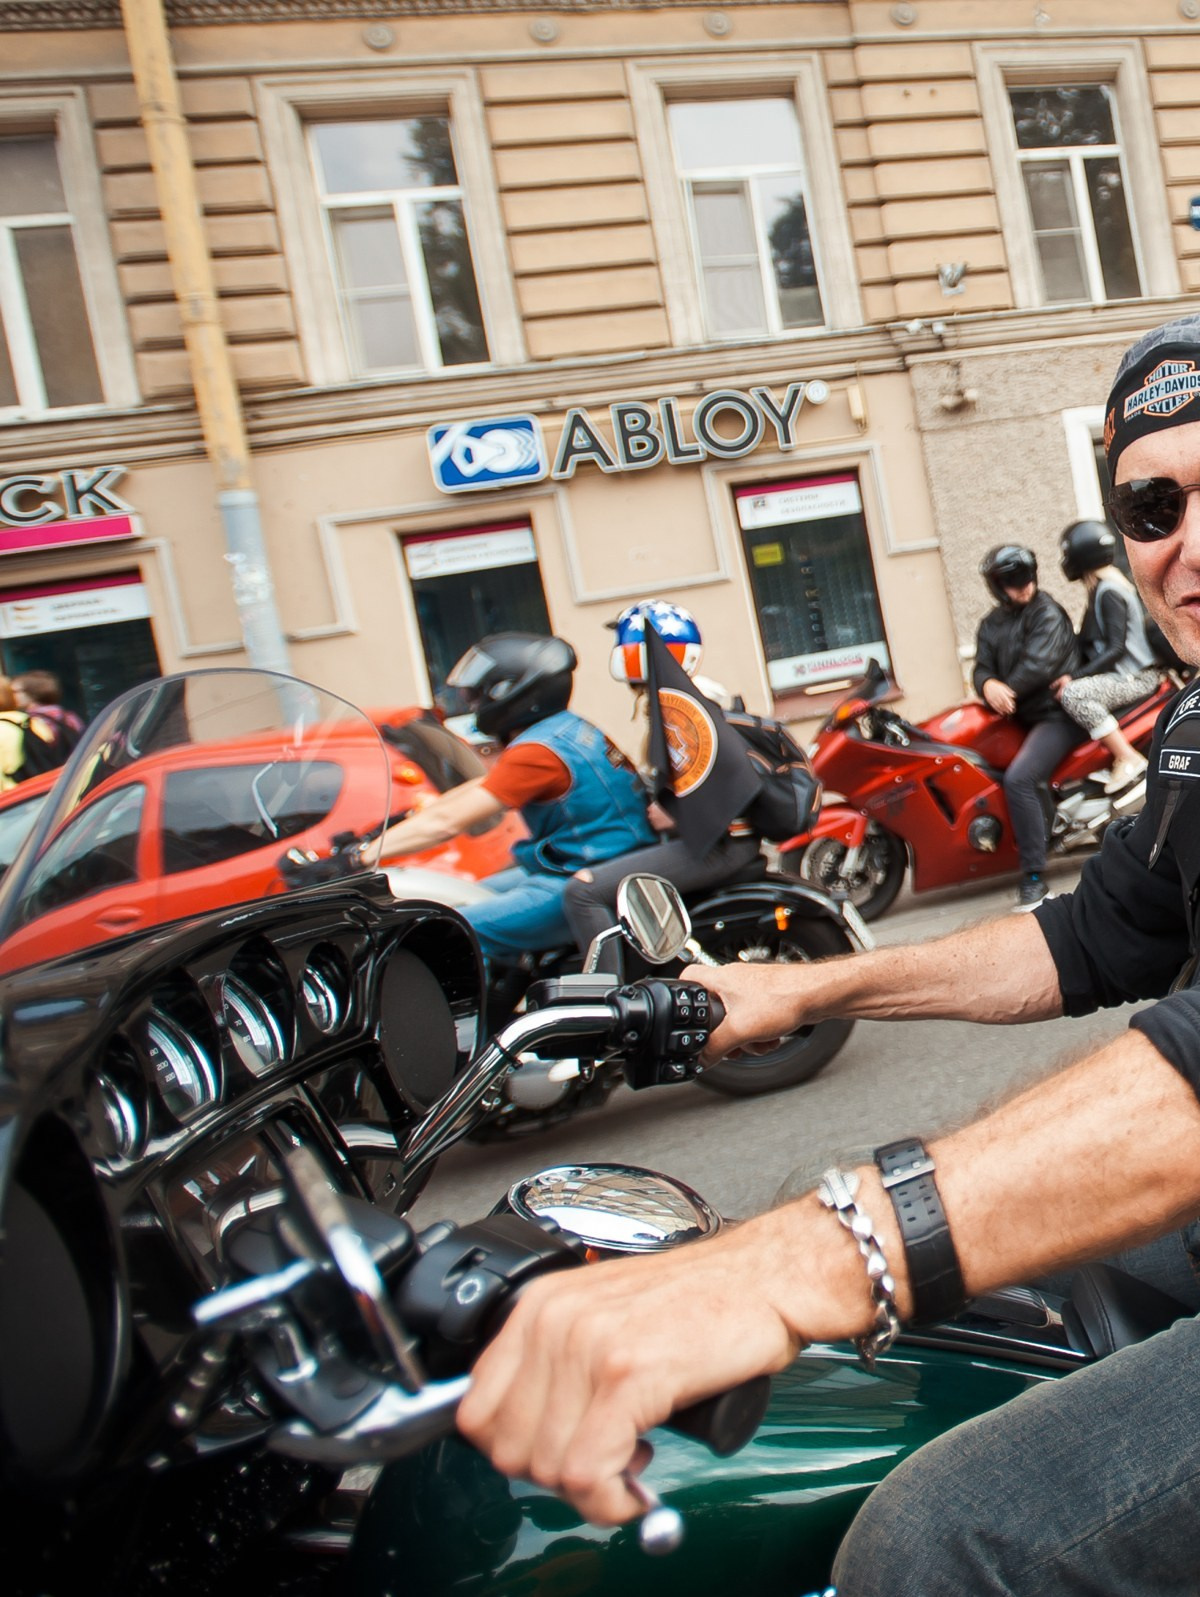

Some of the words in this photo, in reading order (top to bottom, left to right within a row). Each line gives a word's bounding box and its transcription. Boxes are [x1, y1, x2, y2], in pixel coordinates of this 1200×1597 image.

[1147, 362, 1189, 384] MOTOR
[1147, 393, 1190, 413] CYCLES
[551, 382, 806, 480] ABLOY
[1179, 696, 1199, 715] LIFE
[1169, 755, 1191, 770] GRAF
